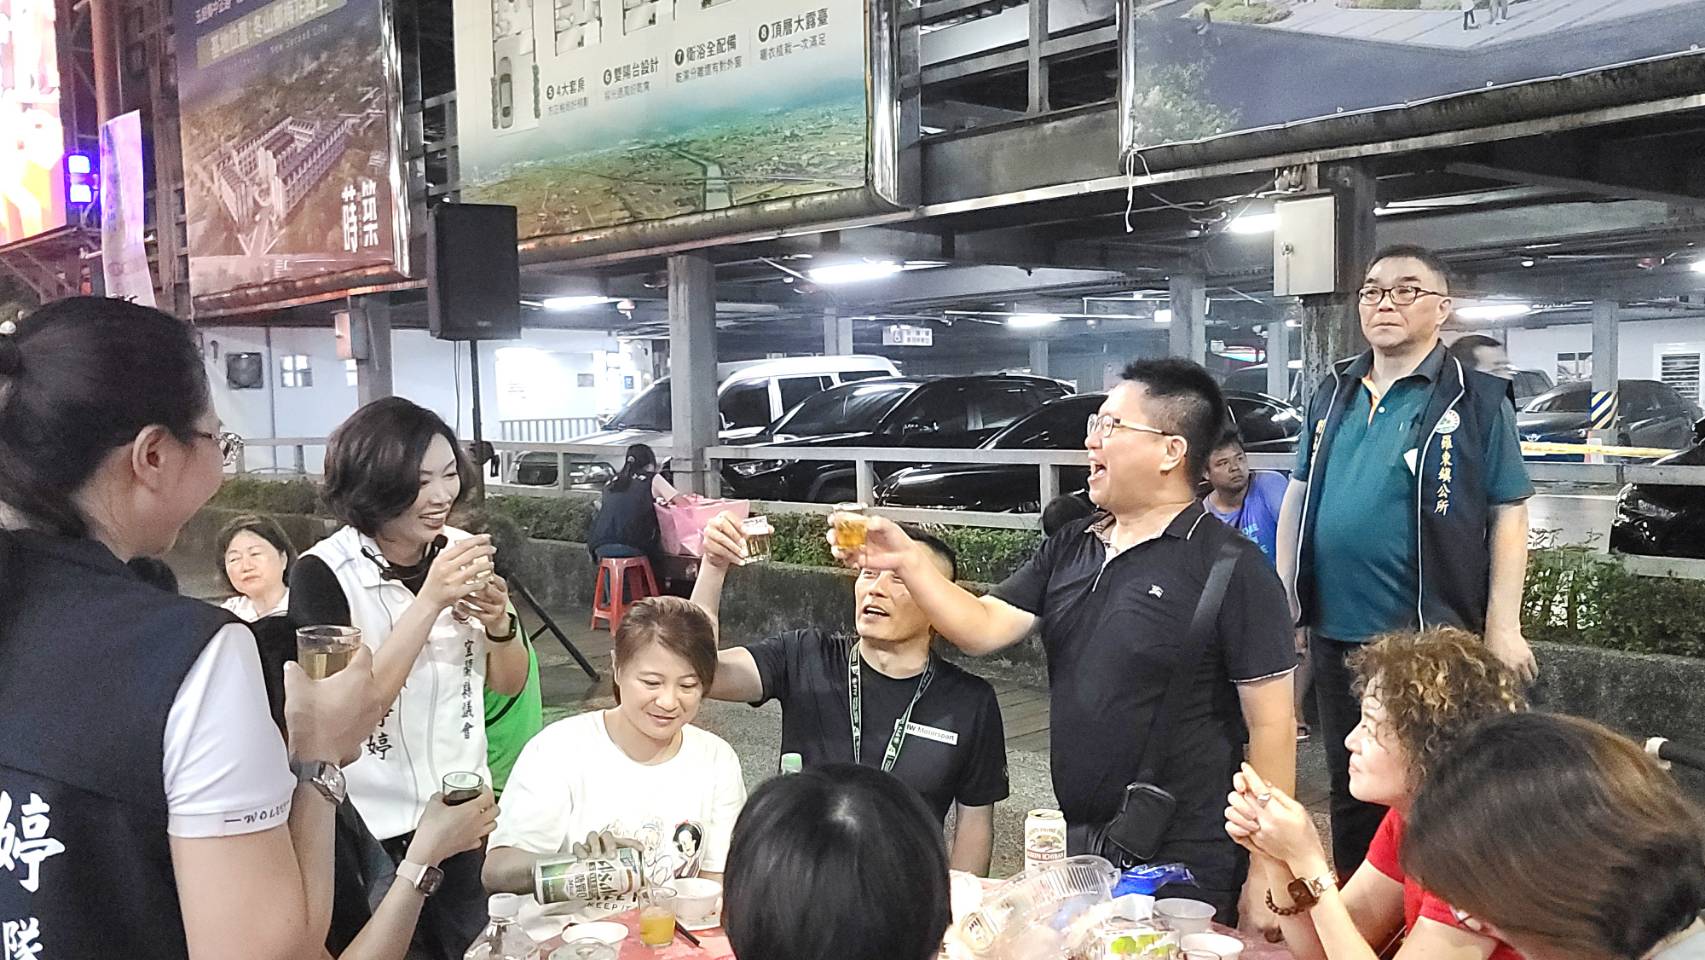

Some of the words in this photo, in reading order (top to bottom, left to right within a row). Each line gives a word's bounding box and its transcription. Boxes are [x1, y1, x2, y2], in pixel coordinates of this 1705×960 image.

[1434, 434, 1453, 517] 羅東鎮公所
[0, 790, 66, 893] 婷
